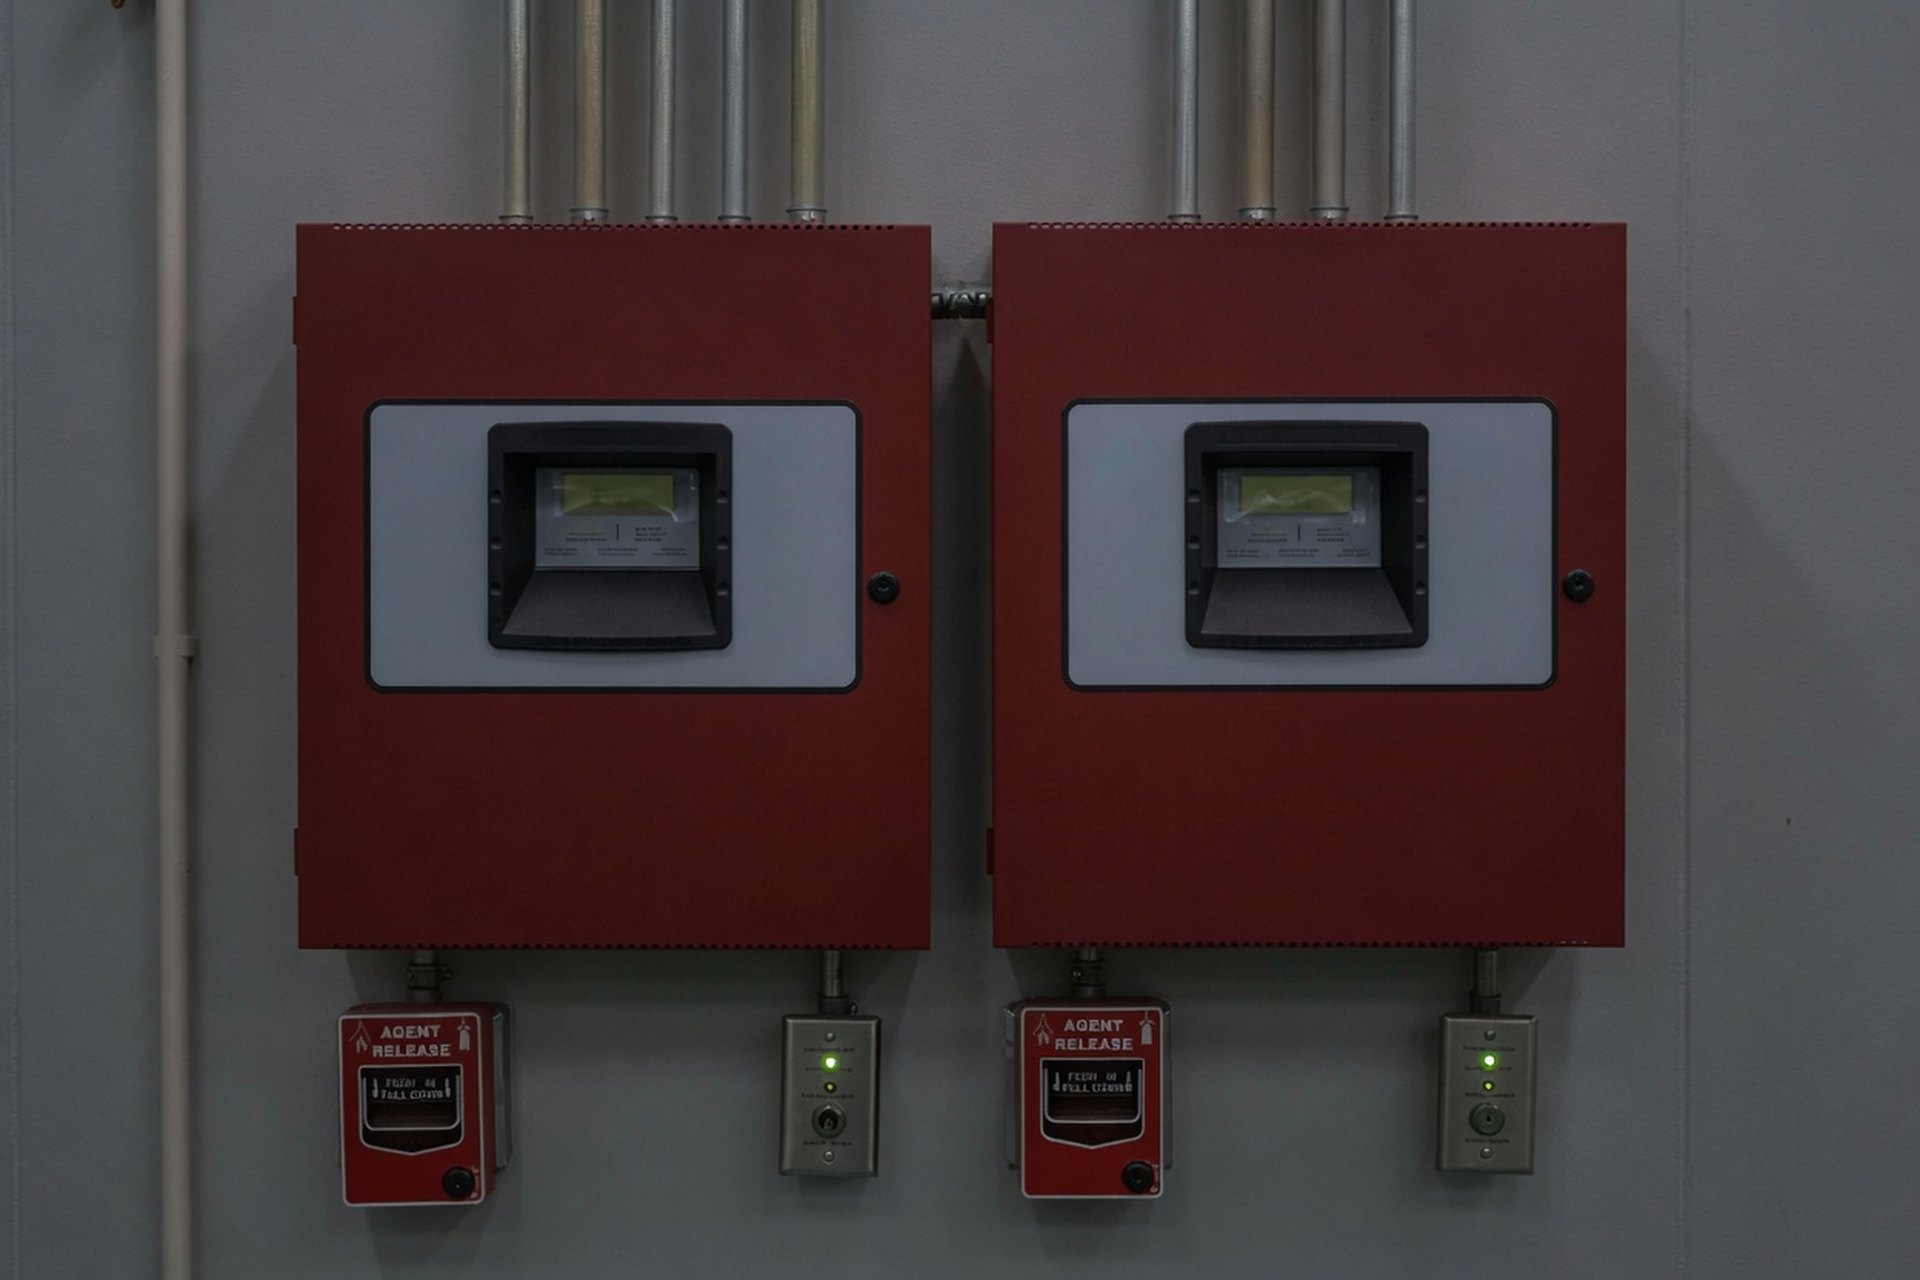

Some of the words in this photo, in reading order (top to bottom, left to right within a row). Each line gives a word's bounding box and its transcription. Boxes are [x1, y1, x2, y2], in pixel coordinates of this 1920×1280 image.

[380, 1025, 441, 1039] AGENT
[1063, 1019, 1124, 1032] AGENT
[372, 1043, 451, 1058] RELEASE
[1055, 1038, 1133, 1051] RELEASE
